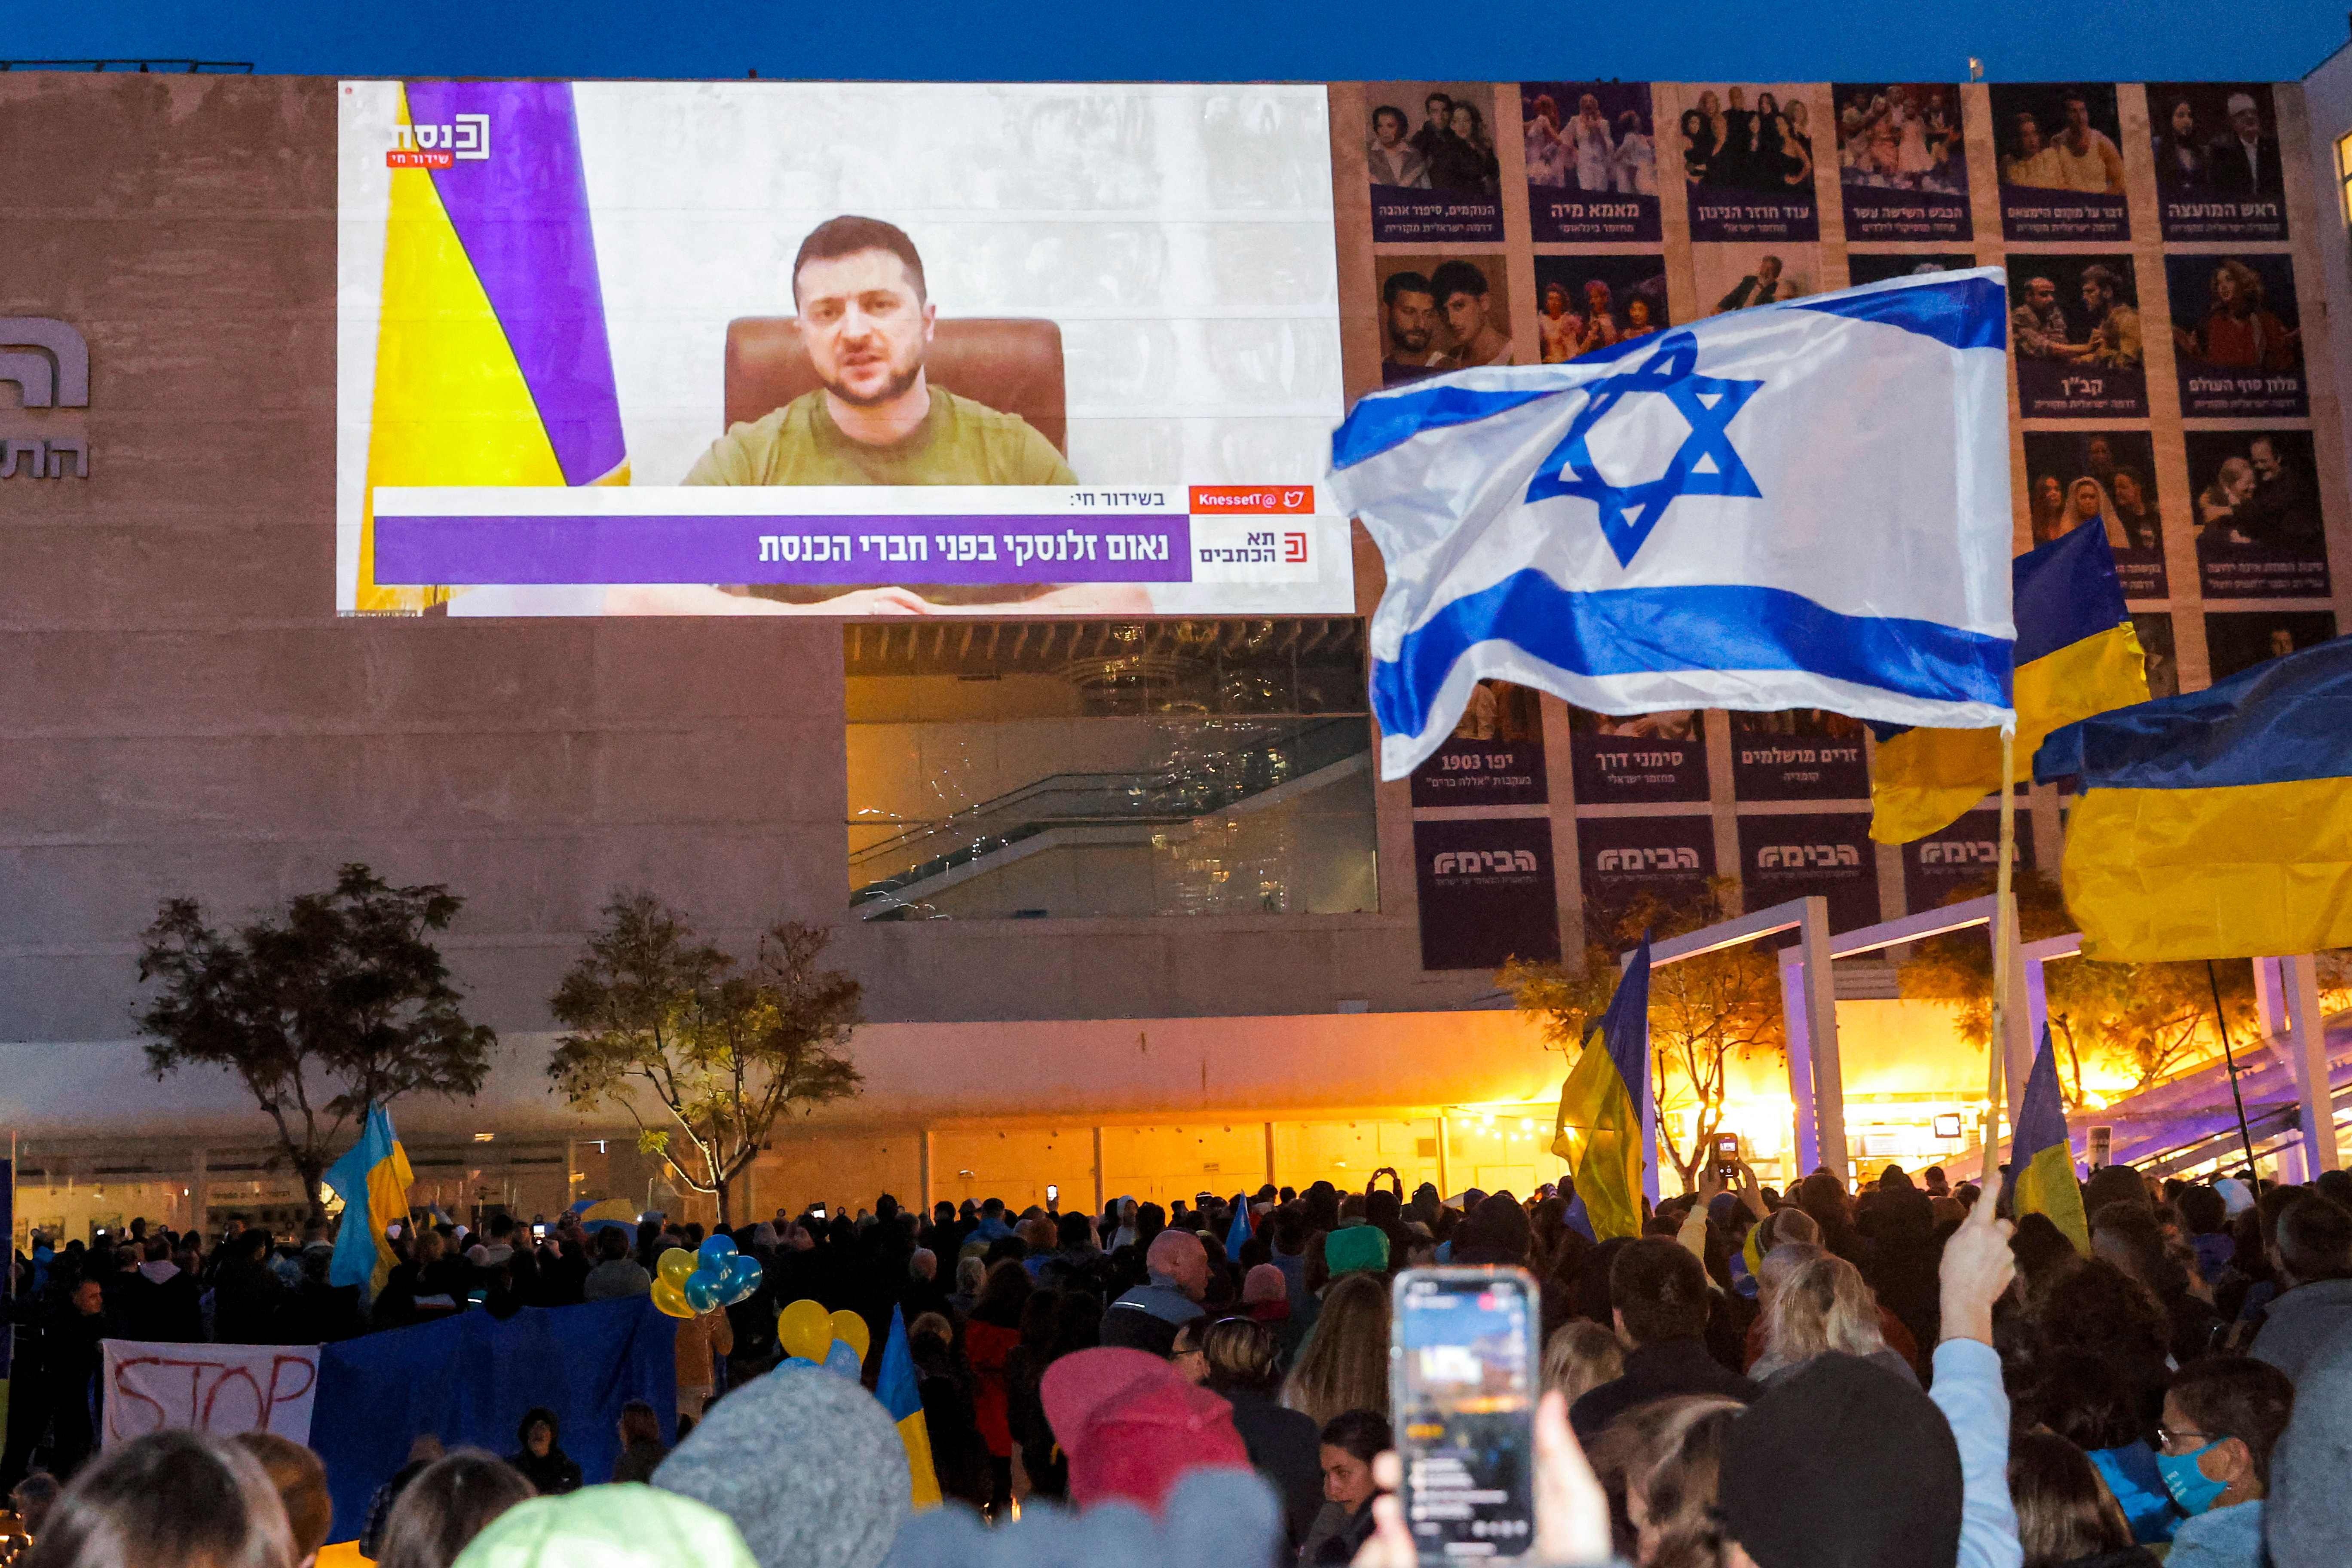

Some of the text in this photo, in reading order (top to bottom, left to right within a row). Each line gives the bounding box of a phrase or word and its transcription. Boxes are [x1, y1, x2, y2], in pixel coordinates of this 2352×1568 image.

[390, 114, 490, 159] כנסת
[392, 154, 449, 164] שידור חי
[1379, 205, 1409, 216] אהבה
[1412, 205, 1442, 216] סיפור
[1551, 204, 1639, 217] מאמא מיה
[1698, 206, 1809, 221] עוד חוזר הניגון
[2168, 204, 2277, 219] ראש המועצה
[2189, 377, 2297, 393] מלון סוף העולם
[1070, 491, 1166, 506] בשידור חי:
[1247, 532, 1275, 546] תא
[759, 529, 1169, 567] נאום זלנסקי בפני חברי הכנסת
[1200, 548, 1276, 563] הכתבים
[1442, 754, 1513, 770] יפו 1903
[1596, 751, 1683, 770] סימני דרך
[1742, 746, 1857, 764] זרים מושלמים
[1493, 776, 1532, 786] בעקבות
[1607, 773, 1675, 784] מחזמר ישראלי
[1434, 850, 1537, 874] הבימה
[1597, 847, 1699, 871] הבימה
[1758, 844, 1859, 867] הבימה
[110, 1354, 315, 1440] STOP
